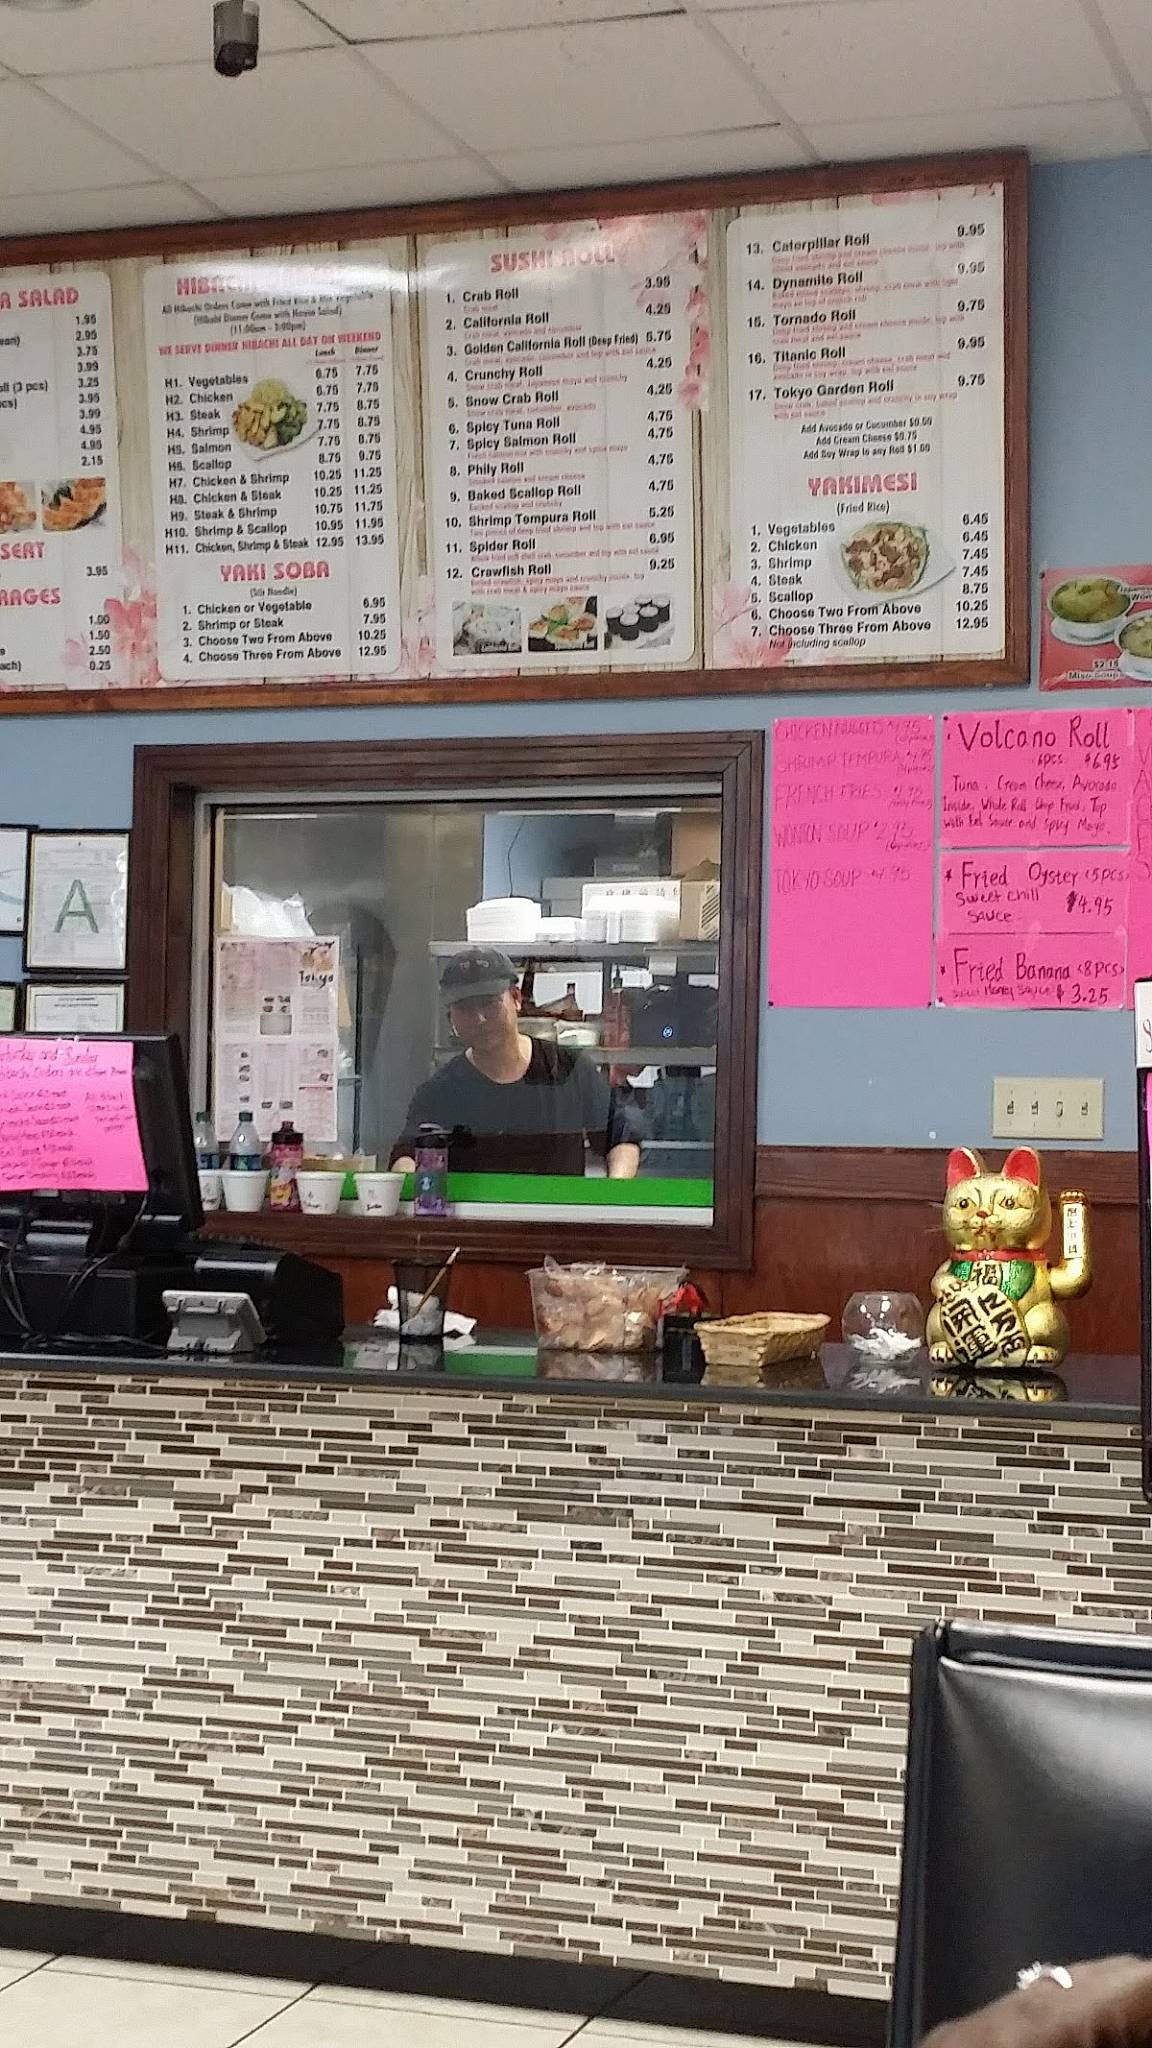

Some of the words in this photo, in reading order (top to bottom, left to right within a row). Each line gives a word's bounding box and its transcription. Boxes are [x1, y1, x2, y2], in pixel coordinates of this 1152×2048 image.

[772, 237, 840, 254] Caterpillar
[845, 234, 870, 246] Roll
[957, 224, 985, 236] 9.95
[491, 250, 552, 273] SUSHI
[463, 291, 491, 302] Crab
[495, 289, 519, 300] Roll
[645, 276, 670, 289] 3.95
[773, 275, 833, 290] Dynamite
[838, 272, 862, 284] Roll
[19, 287, 79, 307] SALAD
[464, 314, 521, 329] California
[525, 312, 549, 324] Roll
[646, 303, 671, 315] 4.25
[773, 313, 826, 326] Tornado
[831, 310, 856, 322] Roll
[958, 299, 985, 311] 9.75
[464, 343, 503, 355] Golden
[507, 339, 560, 352] California
[564, 337, 585, 349] Roll
[614, 334, 638, 345] Fried)
[646, 331, 671, 342] 5.75
[774, 350, 816, 362] Titanic
[821, 347, 846, 359] Roll
[958, 337, 985, 349] 9.95
[465, 369, 515, 381] Crunchy
[519, 366, 542, 377] Roll
[647, 357, 672, 369] 4.25
[188, 375, 248, 389] Vegetables
[774, 386, 813, 400] Tokyo
[817, 383, 864, 396] Garden
[868, 380, 894, 392] Roll
[958, 375, 985, 386] 9.75
[190, 392, 233, 403] Chicken
[466, 396, 498, 407] Snow
[503, 394, 531, 405] Crab
[535, 391, 558, 402] Roll
[647, 384, 672, 396] 4.25
[190, 409, 220, 420] Steak
[191, 427, 229, 438] Shrimp
[467, 421, 499, 434] Spicy
[505, 419, 532, 430] Tuna
[537, 417, 560, 428] Roll
[192, 443, 231, 453] Salmon
[467, 438, 499, 451] Spicy
[504, 435, 548, 447] Salmon
[552, 433, 576, 445] Roll
[648, 427, 673, 439] 4.75
[193, 460, 231, 471] Scallop
[468, 464, 497, 476] Phily
[501, 462, 524, 474] Roll
[648, 453, 673, 465] 4.75
[193, 477, 236, 488] Chicken
[251, 473, 289, 485] Shrimp
[314, 470, 341, 481] 10.25
[354, 467, 381, 478] 11.25
[808, 472, 917, 496] YAKIMESI
[193, 493, 236, 504] Chicken
[252, 490, 281, 501] Steak
[314, 487, 342, 497] 10.25
[354, 484, 382, 495] 11.25
[468, 489, 505, 501] Baked
[510, 487, 553, 499] Scallop
[558, 485, 581, 496] Roll
[649, 480, 673, 491] 4.75
[195, 510, 224, 520] Steak
[239, 507, 277, 519] Shrimp
[315, 504, 342, 514] 10.75
[354, 501, 382, 512] 11.75
[469, 515, 511, 528] Shrimp
[515, 513, 568, 525] Tempura
[573, 510, 596, 521] Roll
[649, 506, 674, 518] 5.25
[837, 502, 864, 516] (Fried
[867, 500, 890, 514] Rice)
[195, 526, 233, 538] Shrimp
[248, 524, 287, 535] Scallop
[316, 520, 343, 531] 10.95
[355, 518, 383, 528] 11.95
[768, 522, 835, 536] Vegetables
[195, 542, 235, 553] Chicken,
[238, 541, 270, 551] Shrimp
[283, 539, 309, 548] Steak
[316, 537, 344, 548] 12.95
[356, 534, 384, 546] 13.95
[470, 541, 508, 553] Spider
[512, 539, 536, 550] Roll
[768, 540, 817, 551] Chicken
[769, 558, 811, 570] Shrimp
[963, 548, 988, 560] 7.45
[220, 563, 266, 582] YAKI
[274, 561, 329, 580] SOBA
[471, 567, 524, 579] Crawfish
[528, 564, 551, 576] Roll
[769, 575, 802, 585] Steak
[962, 566, 988, 577] 7.45
[769, 592, 813, 603] Scallop
[962, 583, 988, 594] 8.75
[198, 604, 240, 615] Chicken
[258, 601, 312, 614] Vegetable
[769, 608, 814, 620] Choose
[818, 607, 843, 617] Two
[847, 605, 878, 616] From
[882, 603, 921, 615] Above
[956, 600, 988, 612] 10.25
[198, 620, 236, 632] Shrimp
[254, 618, 283, 628] Steak
[363, 614, 386, 624] 7.95
[769, 625, 814, 637] Choose
[819, 623, 852, 634] Three
[857, 622, 888, 633] From
[892, 620, 931, 631] Above
[956, 617, 988, 629] 12.95
[198, 636, 238, 646] Choose
[242, 635, 264, 644] Two
[268, 634, 295, 644] From
[299, 632, 332, 643] Above
[358, 630, 386, 641] 10.25
[832, 638, 865, 648] scallop
[199, 651, 238, 662] Choose
[242, 650, 272, 661] Three
[277, 649, 304, 659] From
[307, 648, 341, 658] Above
[359, 646, 386, 657] 12.95
[958, 720, 1056, 752] Volcano
[1069, 716, 1109, 749] Roll
[1073, 774, 1117, 792] Avocado
[962, 861, 1007, 889] Fried
[1029, 862, 1078, 887] Oyster
[54, 879, 99, 933] A
[954, 948, 1003, 984] Fried
[1016, 952, 1070, 980] Banana
